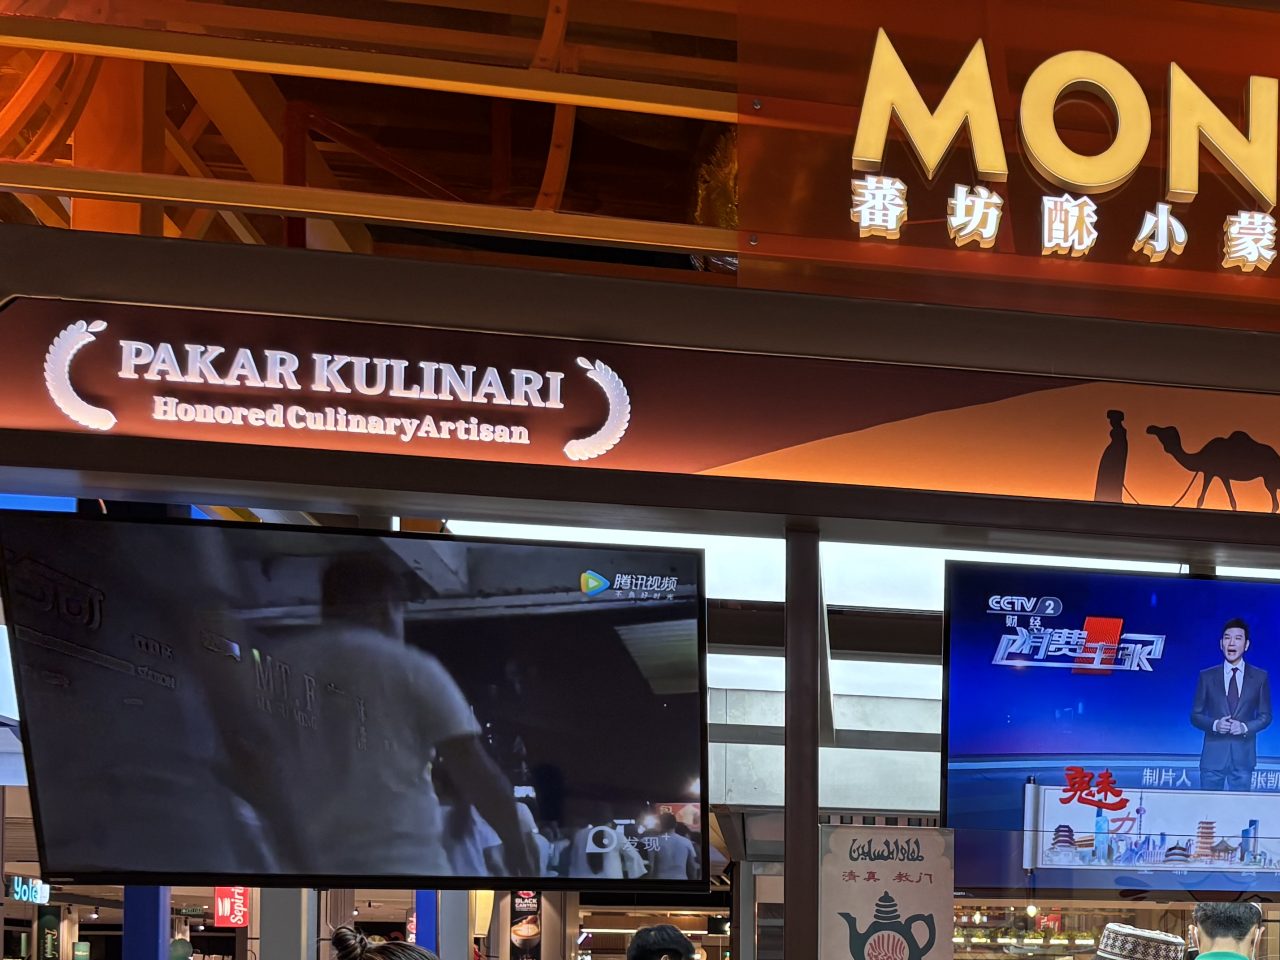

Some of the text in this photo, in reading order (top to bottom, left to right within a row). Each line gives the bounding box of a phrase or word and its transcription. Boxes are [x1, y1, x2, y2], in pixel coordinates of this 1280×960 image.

[851, 27, 1279, 212] MON
[118, 340, 564, 409] PAKAR KULINARI
[153, 395, 530, 445] Honored Culinary Artisan
[613, 573, 678, 591] 腾讯视频
[989, 595, 1055, 614] CCTV 2
[1005, 615, 1042, 628] 财经
[992, 627, 1166, 671] 消费主张
[1142, 768, 1192, 787] 制片人
[623, 836, 661, 851] 发现
